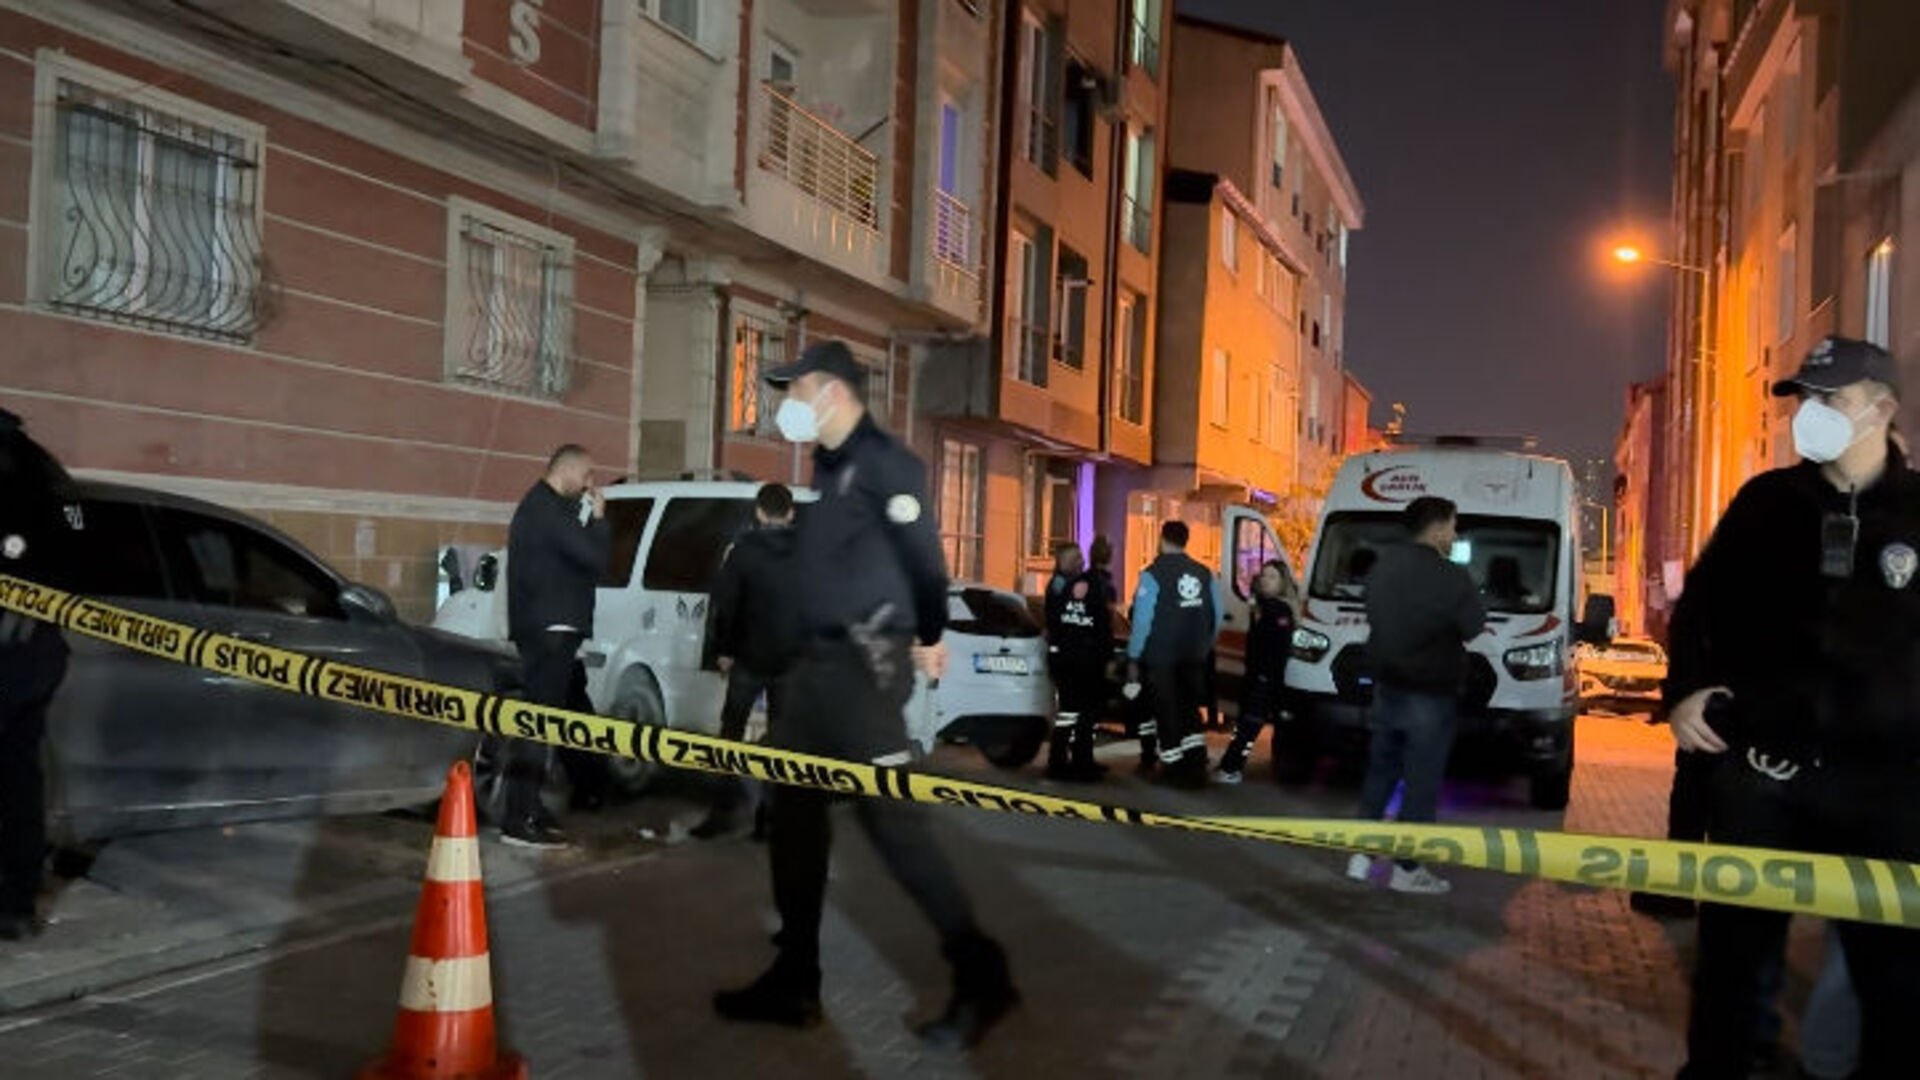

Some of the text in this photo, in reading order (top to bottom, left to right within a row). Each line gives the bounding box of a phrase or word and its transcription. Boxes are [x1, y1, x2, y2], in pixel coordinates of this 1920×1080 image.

[215, 644, 290, 683] POLİS
[326, 672, 466, 723] GİRİLMEZ
[515, 709, 617, 751] POLİS
